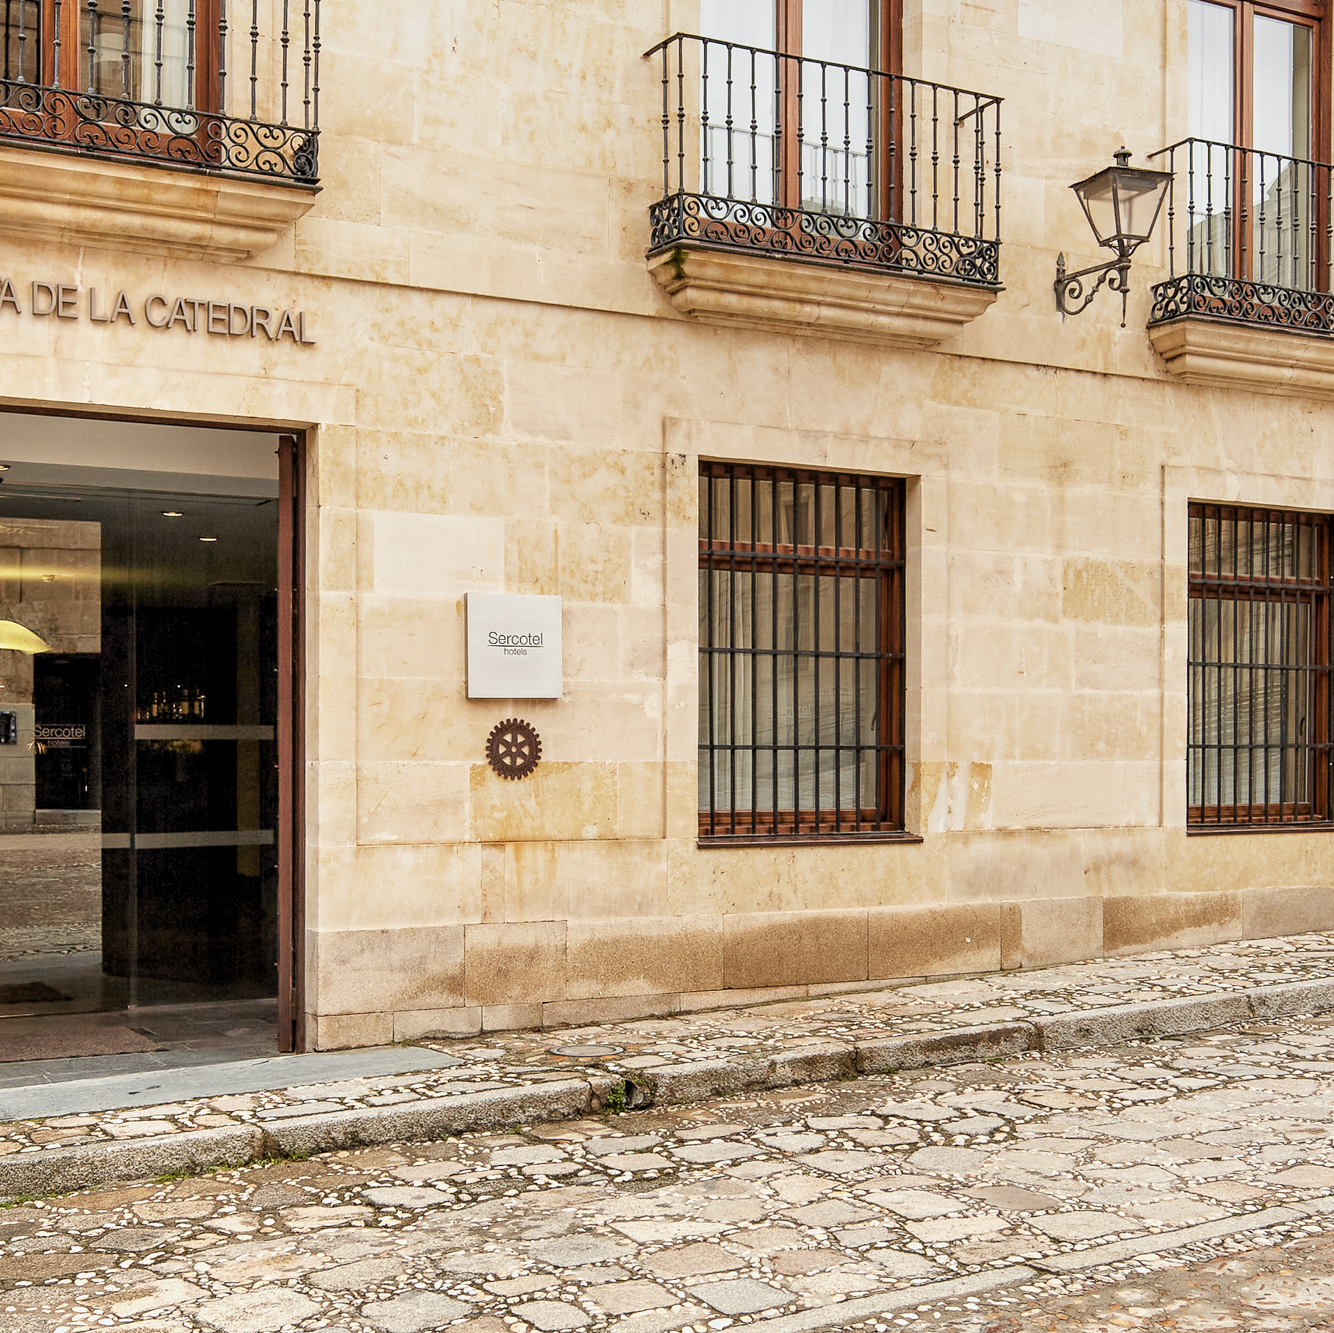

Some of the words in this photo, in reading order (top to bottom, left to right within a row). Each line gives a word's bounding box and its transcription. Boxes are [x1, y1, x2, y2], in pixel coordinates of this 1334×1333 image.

[31, 280, 79, 320] DE
[90, 287, 136, 326] LA
[145, 294, 317, 345] CATEDRAL
[488, 631, 544, 646] Sercotel
[503, 647, 528, 656] hotels
[34, 724, 86, 738] Sercotel
